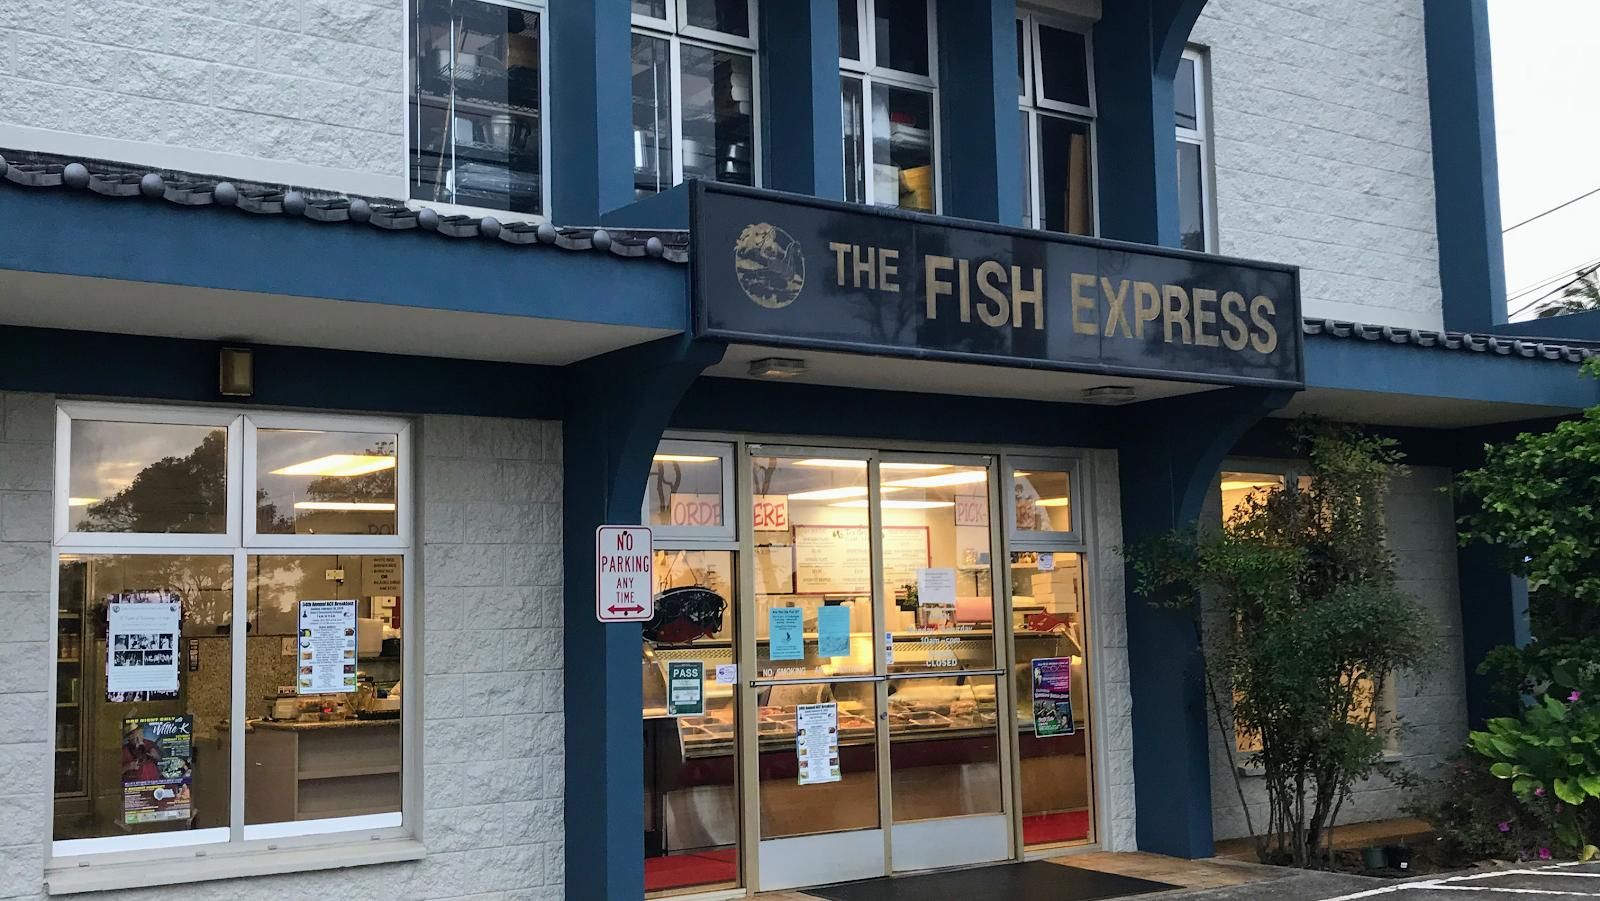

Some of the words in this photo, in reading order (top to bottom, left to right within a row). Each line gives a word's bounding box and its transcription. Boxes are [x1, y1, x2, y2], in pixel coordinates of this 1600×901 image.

[829, 241, 900, 292] THE
[925, 254, 1044, 329] FISH
[1071, 273, 1278, 353] EXPRESS
[674, 501, 720, 526] ORDE
[753, 502, 785, 527] ERE
[957, 502, 987, 523] PICK-
[617, 533, 633, 551] NO
[601, 555, 649, 573] PARKING
[616, 577, 634, 589] ANY
[616, 591, 635, 604] TIME
[926, 658, 957, 667] CLOSED
[673, 668, 698, 678] PASS
[762, 668, 773, 677] NO
[776, 666, 806, 675] SMOKING
[152, 721, 177, 736] Willie
[178, 722, 190, 734] K
